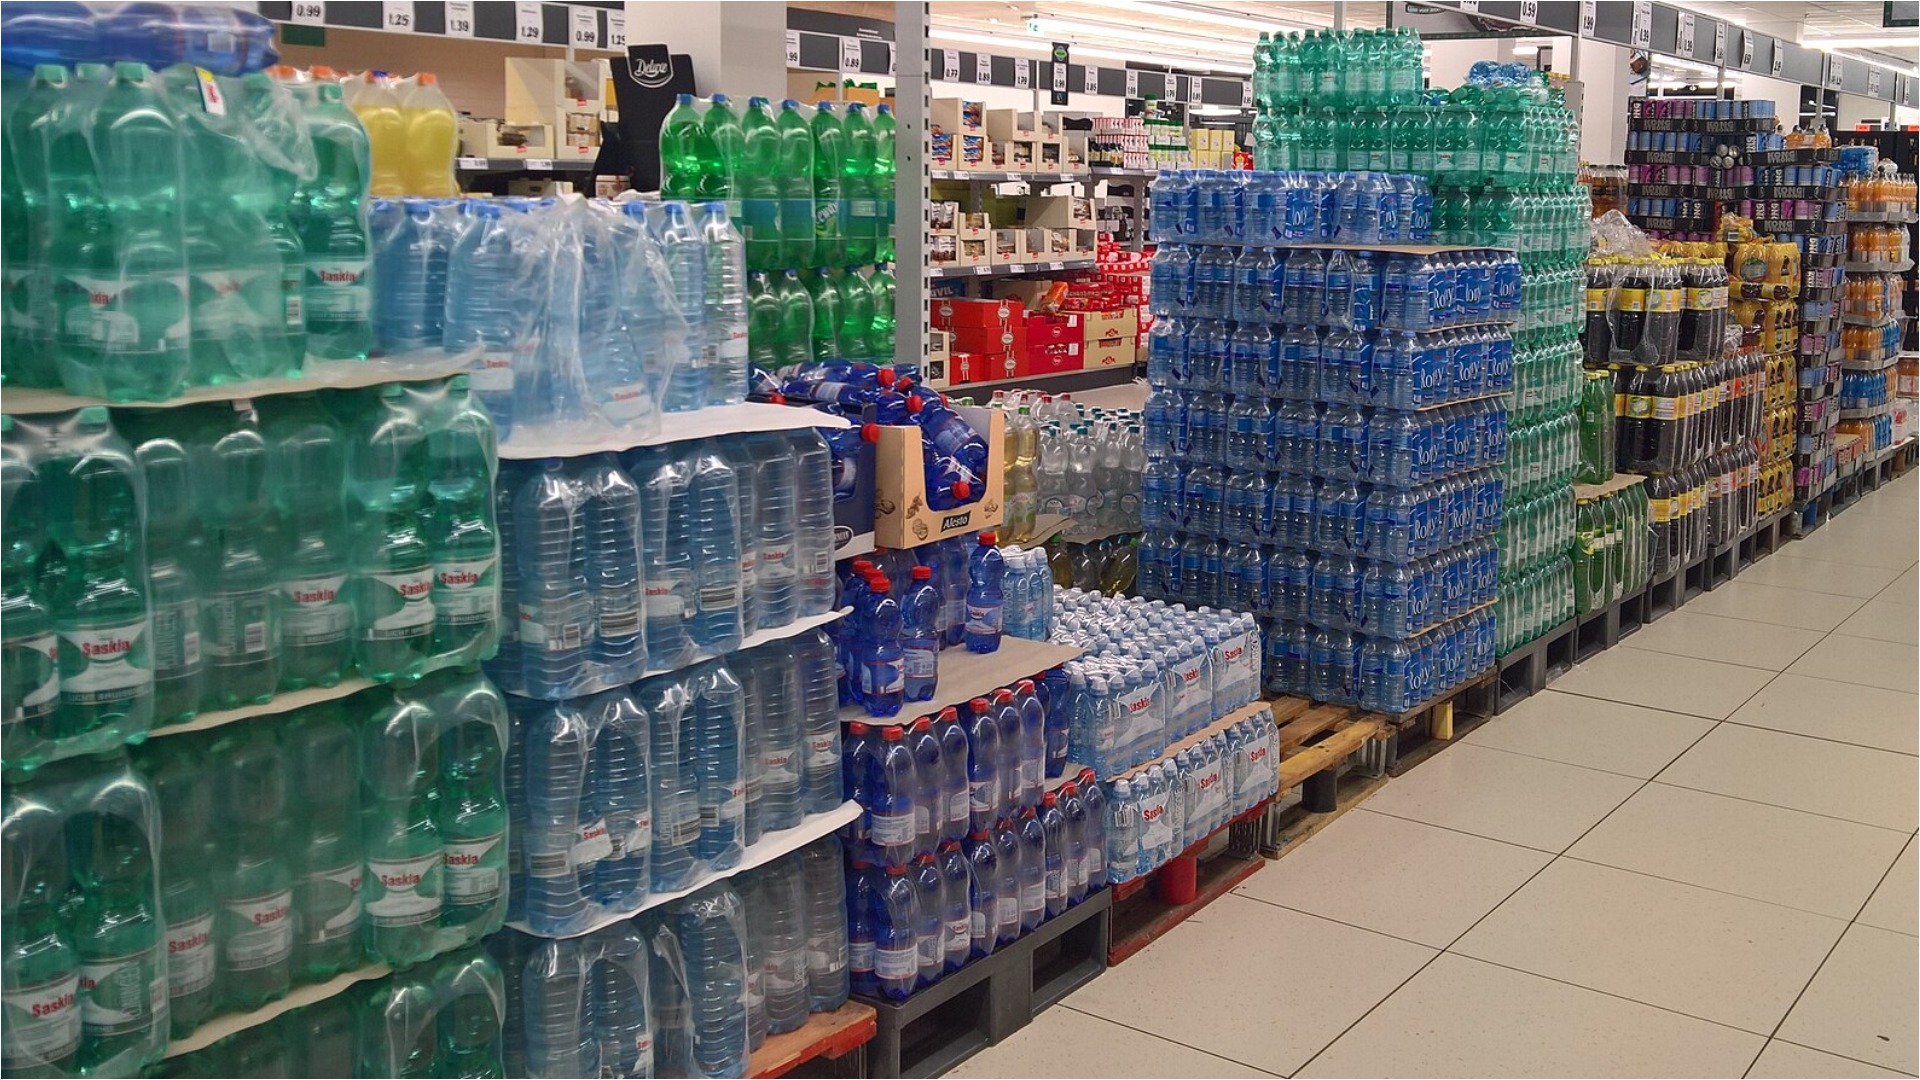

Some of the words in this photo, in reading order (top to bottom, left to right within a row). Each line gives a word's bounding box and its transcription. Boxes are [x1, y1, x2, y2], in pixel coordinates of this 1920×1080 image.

[296, 5, 321, 18] 0.99
[1521, 1, 1537, 18] 0.59
[388, 13, 410, 26] 1.25
[450, 20, 469, 32] 1.39
[520, 25, 539, 38] 1.29
[575, 30, 596, 43] 0.99
[634, 58, 669, 78] Deluxe
[945, 68, 958, 79] 0.77
[318, 269, 357, 285] Saskia
[941, 512, 970, 530] Alesto
[440, 570, 480, 585] Saskia
[292, 588, 337, 604] Saskia
[81, 638, 132, 657] Saskia
[810, 739, 833, 750] Saskia
[583, 826, 606, 841] Saskia
[380, 872, 421, 887] Saskia
[253, 905, 289, 926] Saskia
[167, 932, 209, 954] Saskia
[31, 992, 75, 1019] Saskia
